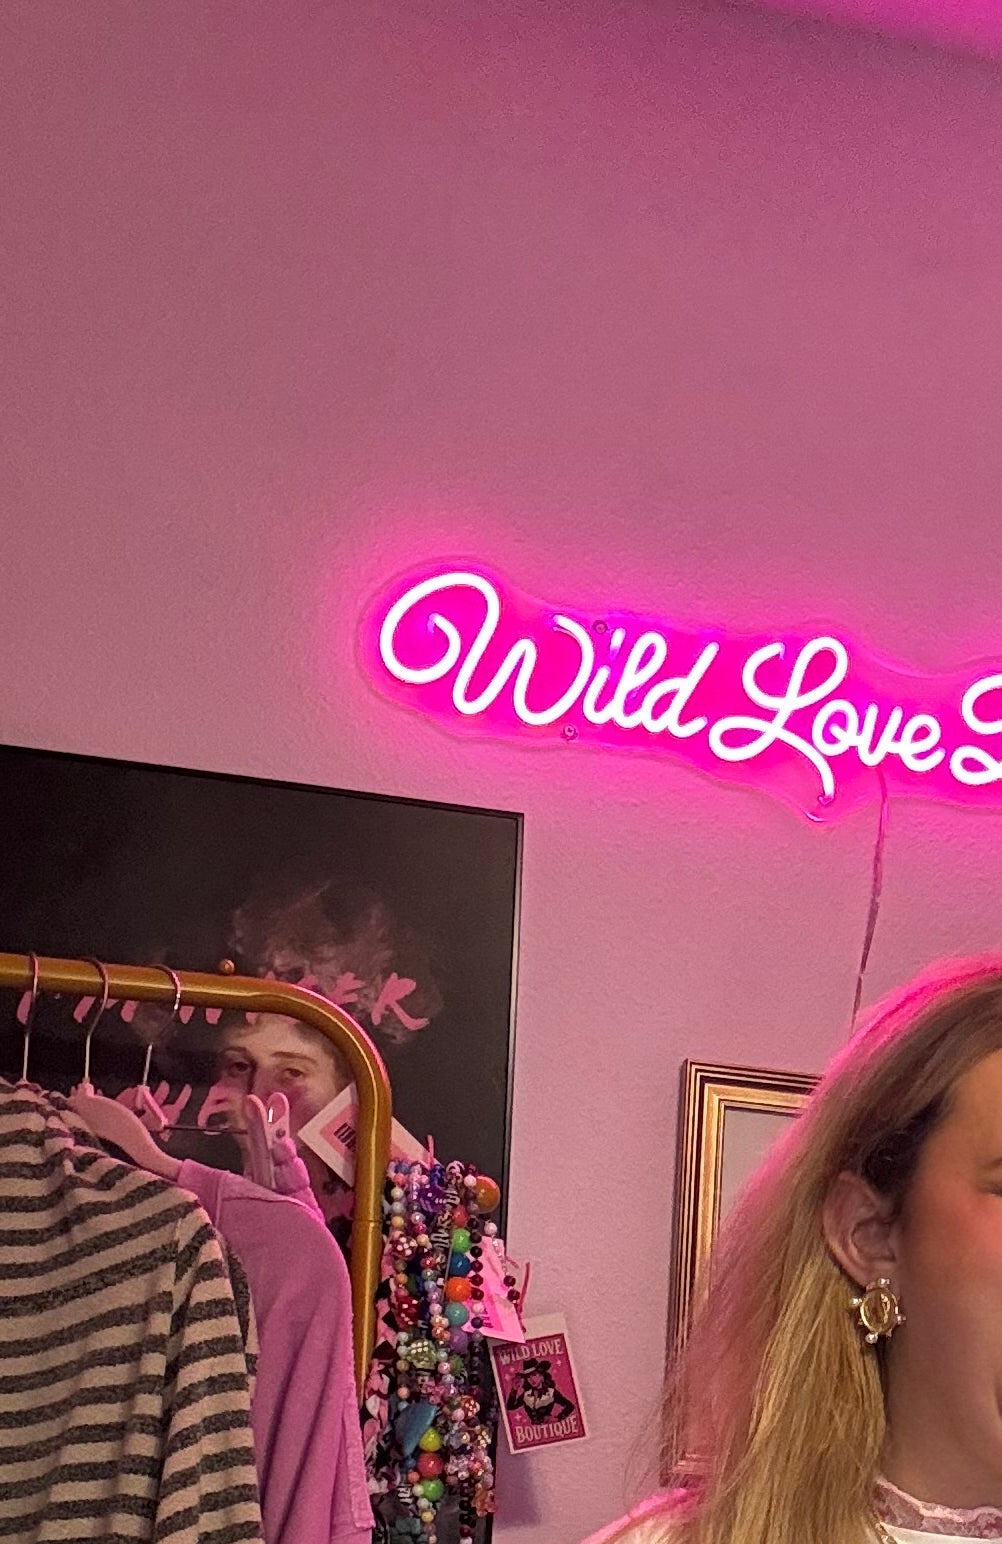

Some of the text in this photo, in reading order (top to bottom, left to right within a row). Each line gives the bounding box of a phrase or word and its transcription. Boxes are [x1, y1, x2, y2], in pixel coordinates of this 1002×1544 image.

[380, 571, 718, 741] Wild
[707, 636, 943, 804] Love
[531, 1339, 564, 1357] LOVE
[515, 1415, 579, 1444] BOUTIQUE
